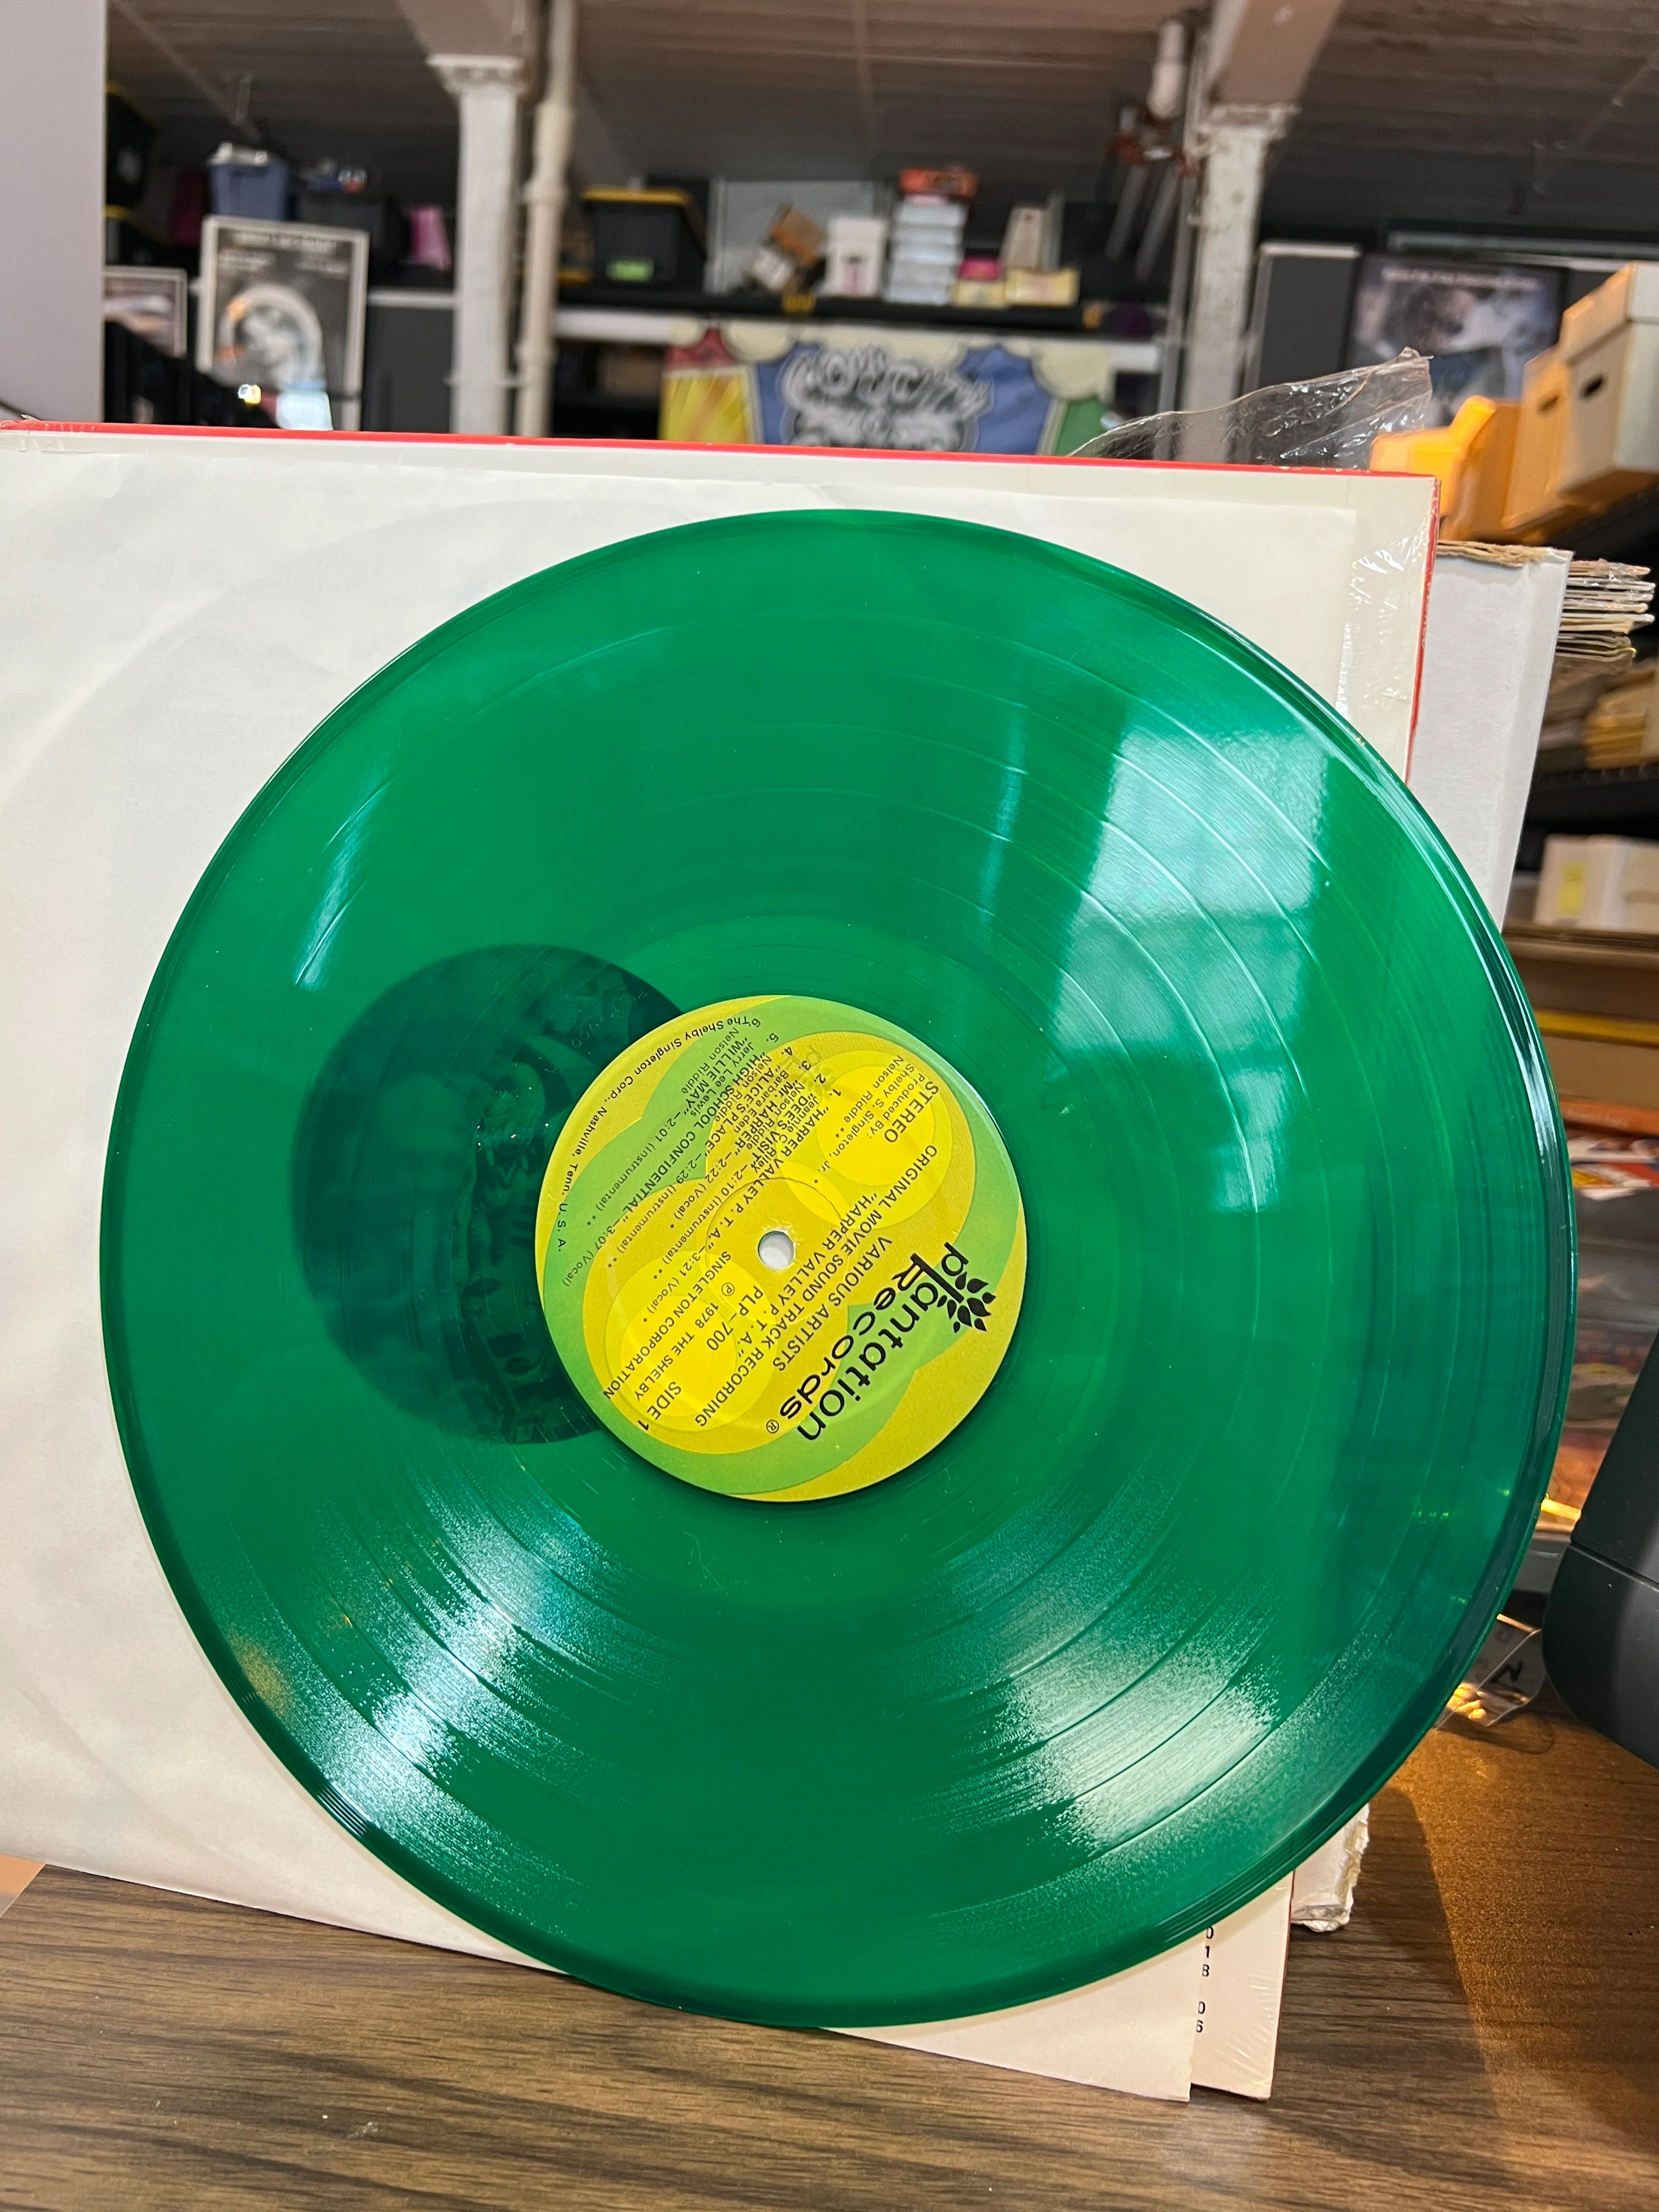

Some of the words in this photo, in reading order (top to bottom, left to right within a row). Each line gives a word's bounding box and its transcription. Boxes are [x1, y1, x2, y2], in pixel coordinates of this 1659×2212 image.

[685, 1020, 724, 1041] Shelby
[727, 1015, 750, 1025] The
[766, 1032, 780, 1043] 5.
[634, 1037, 682, 1075] Singleton
[706, 1037, 748, 1082] "WILLIE
[709, 1026, 740, 1060] Nelson
[731, 1042, 754, 1068] Jerry
[781, 1046, 793, 1060] 4.
[681, 1062, 710, 1094] Riddle
[714, 1068, 733, 1087] Lee
[732, 1051, 765, 1086] "HIGH
[741, 1054, 772, 1088] Nelson
[798, 1060, 812, 1073] 3.
[813, 1073, 826, 1087] 2.
[872, 1054, 904, 1088] Nelson
[883, 1063, 915, 1099] Shelby
[604, 1076, 634, 1103] Corp.,
[690, 1088, 717, 1117] Lewis
[736, 1064, 781, 1114] "ALICE'S
[755, 1069, 789, 1107] Barbara
[772, 1082, 805, 1118] Nelson
[774, 1079, 798, 1098] "Mr.
[829, 1088, 842, 1097] 1.
[872, 1098, 884, 1108] S.
[882, 1073, 926, 1121] Produced
[693, 1084, 735, 1128] SCHOOL
[712, 1090, 743, 1122] Riddle
[733, 1107, 758, 1133] Eden
[775, 1092, 814, 1130] "DEE'S
[787, 1096, 819, 1133] Jeannie
[843, 1090, 873, 1123] Riddle
[884, 1081, 939, 1143] STEREO
[572, 1106, 608, 1157] Nashville,
[746, 1117, 776, 1150] Riddle
[780, 1106, 829, 1157] "HARPER
[829, 1110, 874, 1157] Singleton,
[866, 1120, 885, 1139] By:
[595, 1142, 656, 1211] (Instrumental)
[751, 1144, 777, 1174] Riley
[817, 1160, 831, 1172] Jr.
[561, 1163, 579, 1195] Tenn.
[743, 1156, 785, 1205] VALLEY
[878, 1145, 938, 1209] ORIGINAL
[557, 1203, 568, 1215] U.
[616, 1184, 676, 1254] (Instrumental)
[673, 1183, 707, 1220] (Vocal)
[730, 1202, 744, 1214] P.
[557, 1220, 567, 1232] S.
[662, 1195, 725, 1265] (Instrumental)
[719, 1216, 734, 1227] T.
[821, 1193, 877, 1251] "HARPER
[840, 1209, 883, 1257] MOVIE
[557, 1238, 567, 1251] A.
[562, 1250, 595, 1286] (Vocal)
[673, 1251, 731, 1318] SINGLETON
[777, 1251, 826, 1306] VALLEY
[802, 1254, 844, 1302] SOUND
[828, 1236, 893, 1307] VARIOUS
[646, 1277, 680, 1314] (Vocal)
[763, 1302, 780, 1316] P.
[695, 1302, 719, 1329] 1978
[706, 1285, 764, 1351] PLP-700
[751, 1319, 768, 1331] T.
[760, 1302, 805, 1350] TRACK
[670, 1331, 695, 1356] THE
[737, 1330, 753, 1358] A."
[772, 1302, 830, 1372] ARTISTS
[779, 1252, 928, 1420] Records
[796, 1241, 969, 1441] plantation
[603, 1316, 675, 1400] CORPORATION
[634, 1355, 674, 1402] SHELBY
[695, 1347, 765, 1427] RECORDING
[646, 1381, 682, 1421] SIDE
[637, 1419, 650, 1431] 1
